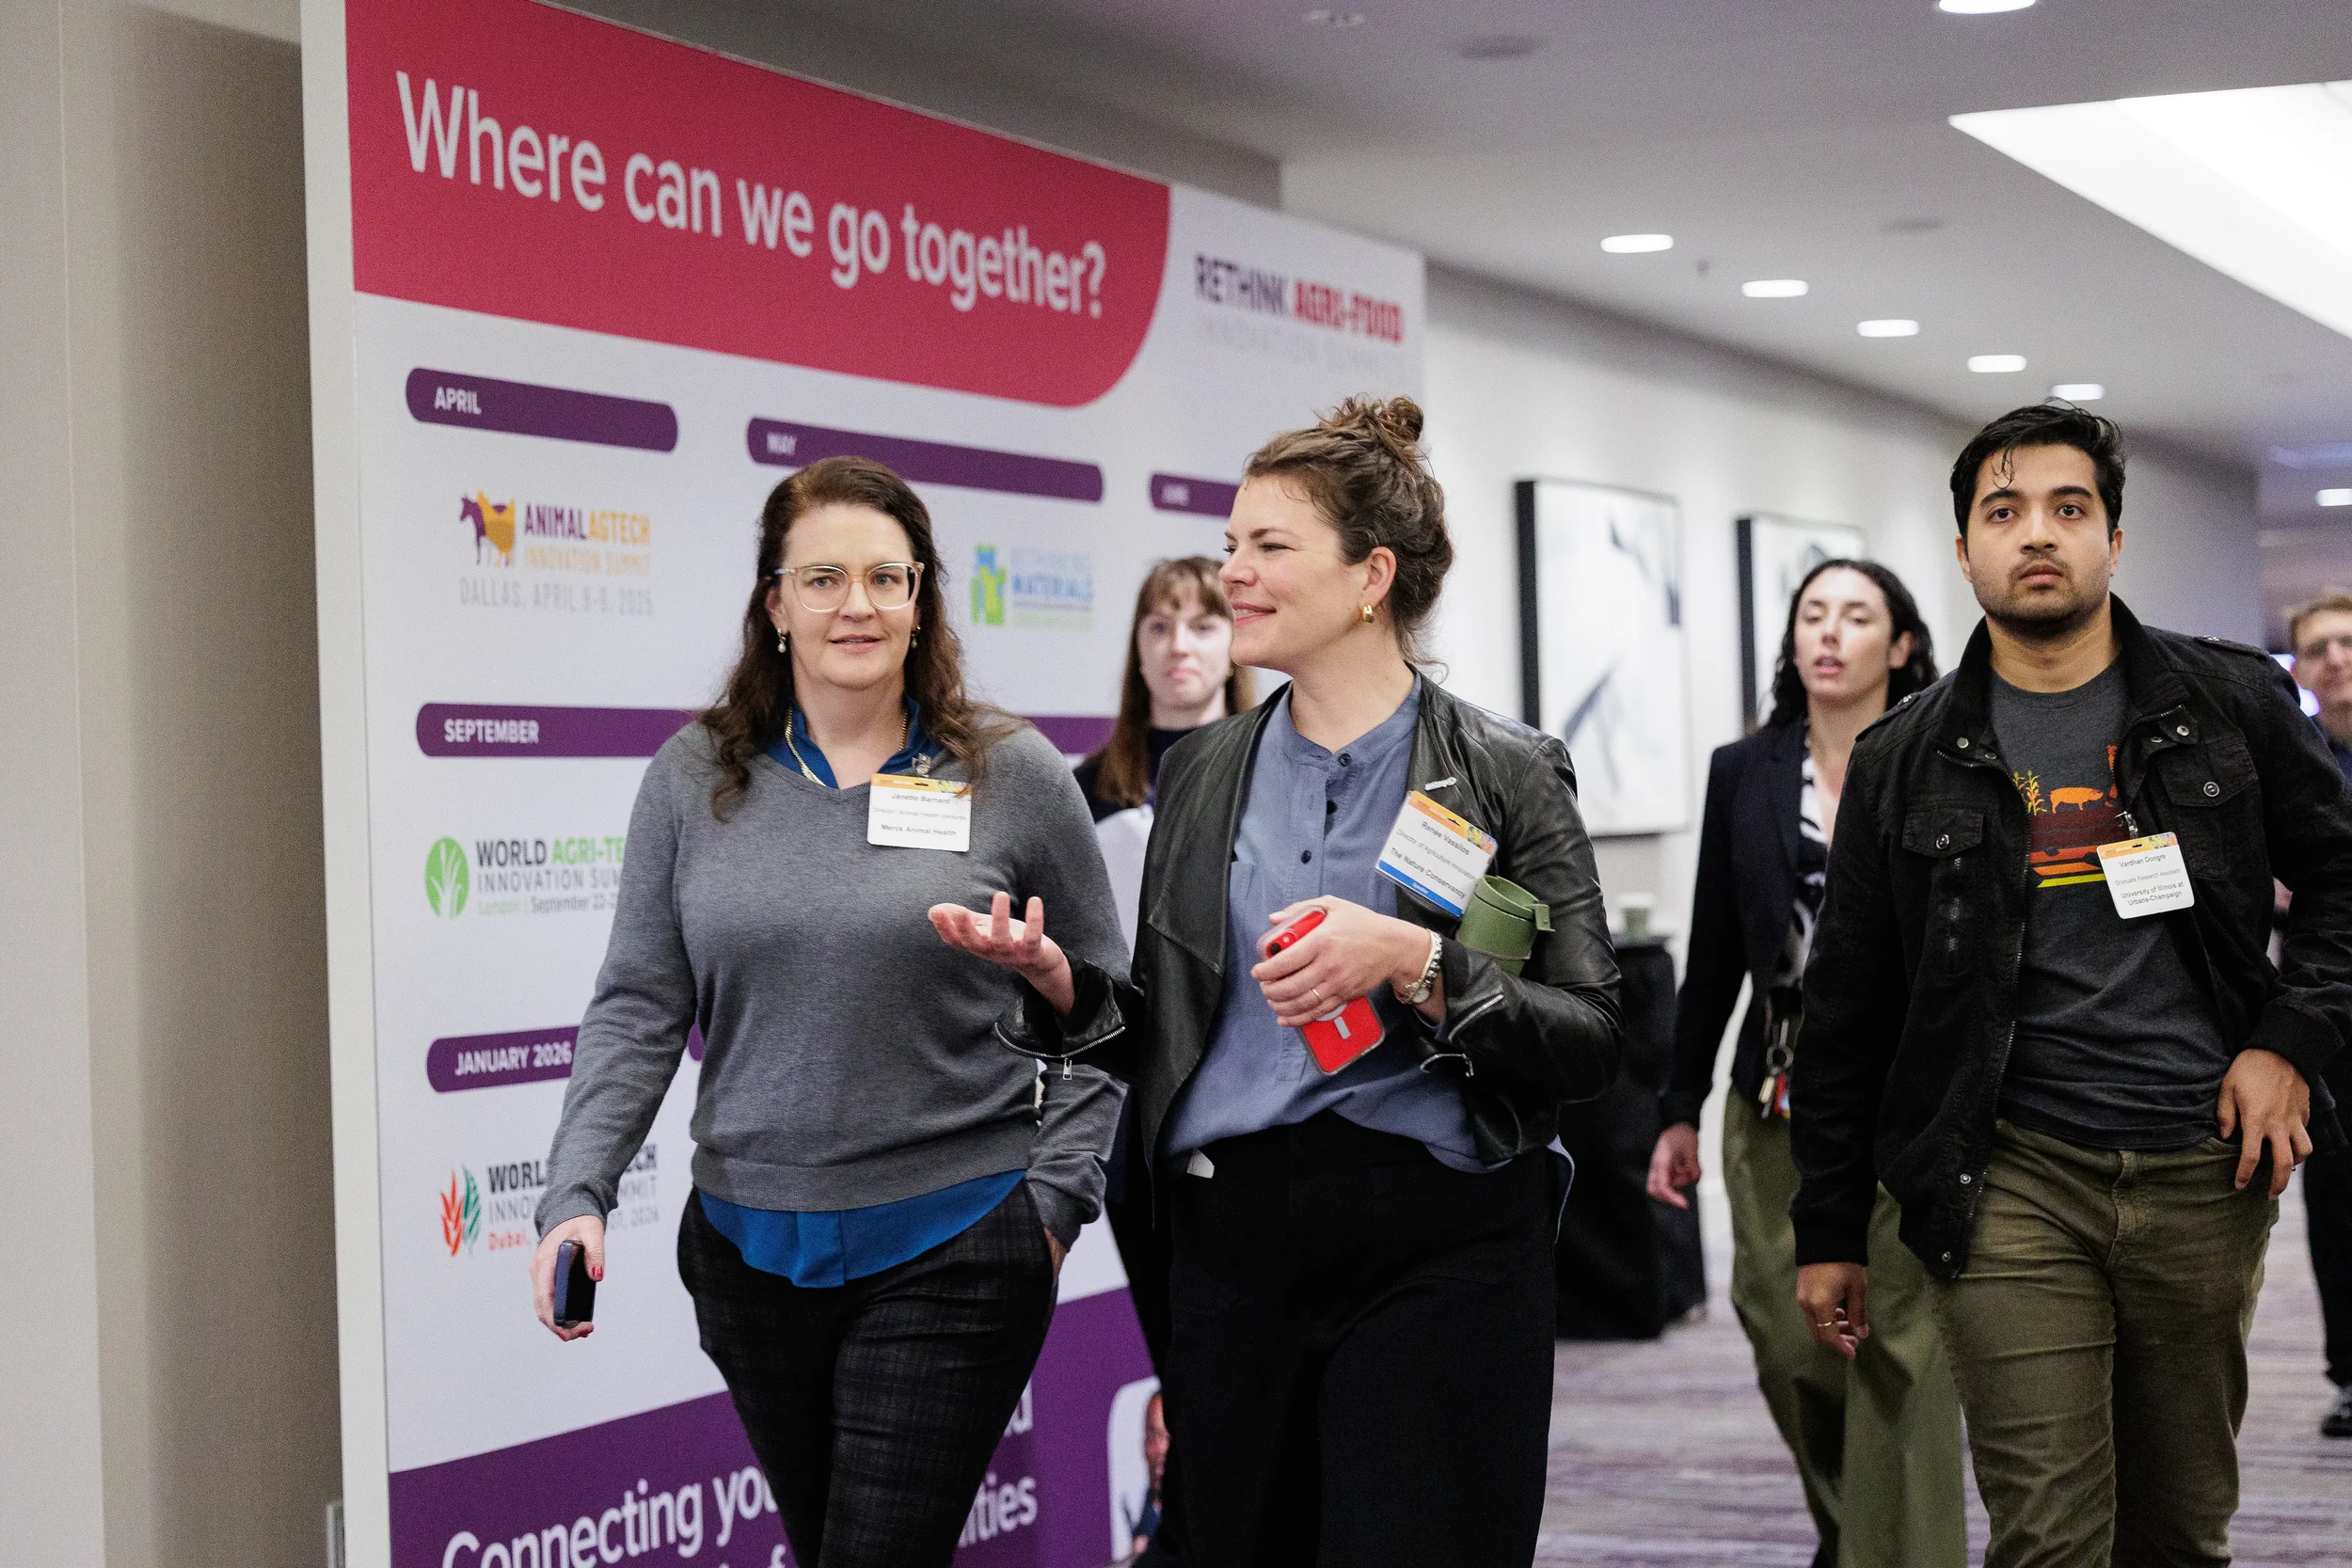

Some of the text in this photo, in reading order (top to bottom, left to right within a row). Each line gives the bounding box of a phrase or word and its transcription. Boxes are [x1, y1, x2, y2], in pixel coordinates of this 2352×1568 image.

[395, 70, 1107, 318] Where can we go together?
[434, 386, 483, 415] APRIL
[532, 580, 579, 612] APRIL
[443, 718, 540, 743] SEPTEMBER
[881, 824, 903, 832] Merck
[475, 836, 626, 867] WORLD AGRI-TE
[2118, 853, 2167, 868] Vardhan Dongre
[477, 867, 584, 893] INNOVATION
[1391, 847, 1466, 900] The Nature Conservancy
[2114, 868, 2182, 887] Graduate Research Assistant
[2120, 889, 2151, 899] University
[2156, 882, 2177, 892] Illinois
[2126, 890, 2183, 906] Urbana-Champaign
[454, 1040, 572, 1076] JANUARY 2026
[487, 1160, 548, 1194] WORL
